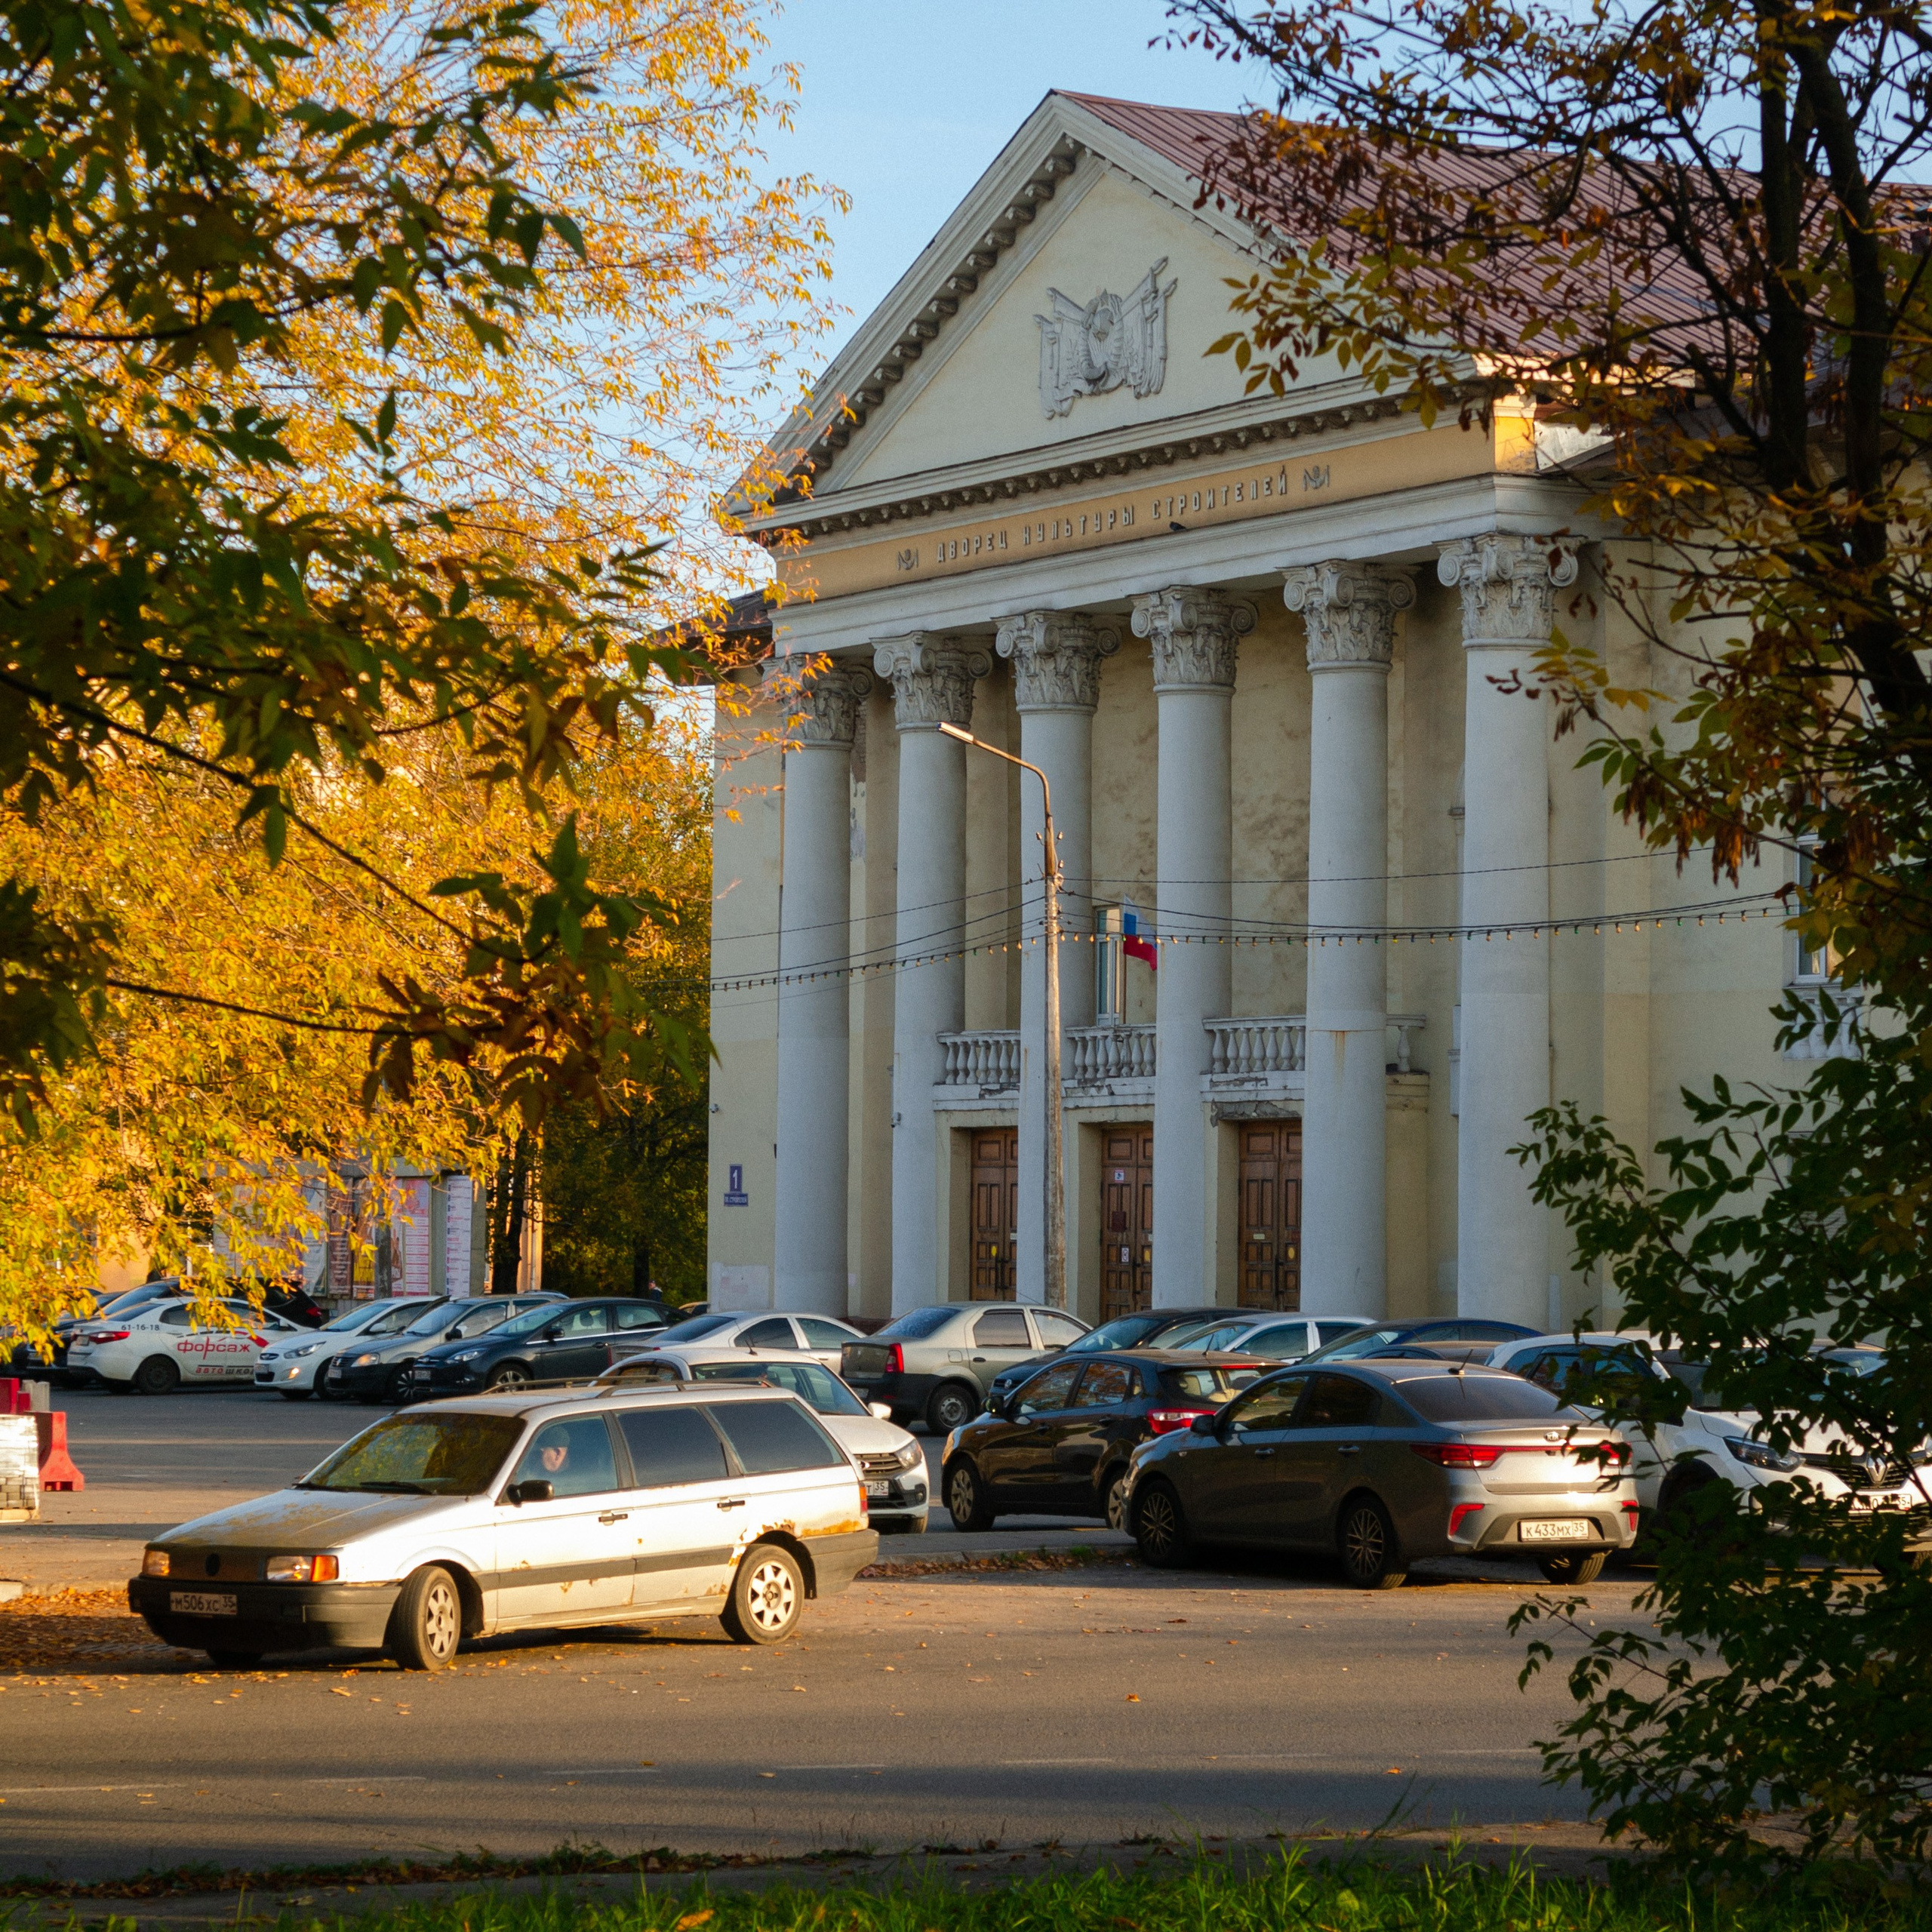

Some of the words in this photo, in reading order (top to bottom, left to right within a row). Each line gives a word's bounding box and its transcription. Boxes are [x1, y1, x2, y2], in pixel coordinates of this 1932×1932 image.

[937, 531, 1008, 563] ДВОРЕЦ
[1023, 505, 1135, 546] КУЛЬТУРЫ
[1152, 465, 1287, 519] СТРОИТЕЛЕЙ
[732, 1169, 738, 1189] 1
[874, 1481, 885, 1491] 35
[1525, 1523, 1572, 1538] К433МХ
[1573, 1522, 1585, 1533] 35
[174, 1594, 220, 1612] М506ХС
[222, 1595, 236, 1608] 35
